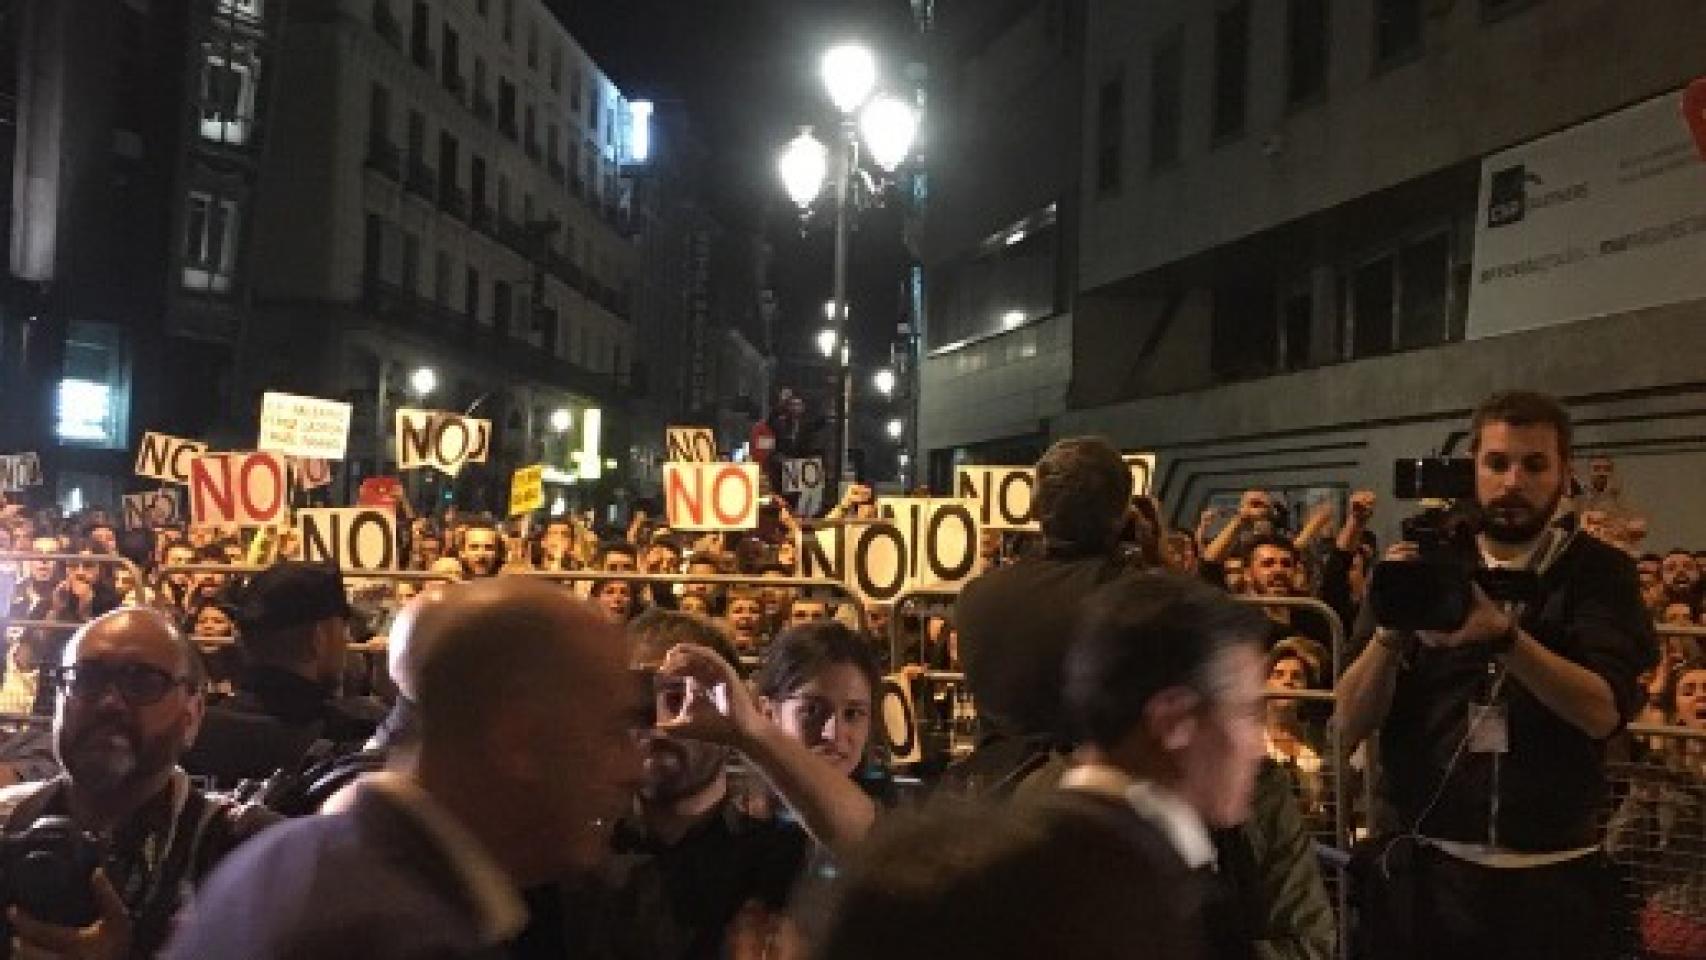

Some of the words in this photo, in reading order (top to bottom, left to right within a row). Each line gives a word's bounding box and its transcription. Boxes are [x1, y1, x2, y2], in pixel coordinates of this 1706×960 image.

[402, 415, 469, 464] NO
[668, 432, 715, 461] NO
[191, 453, 283, 522] NO
[670, 468, 753, 526] NO
[303, 509, 391, 570] NO
[803, 521, 908, 600] NO
